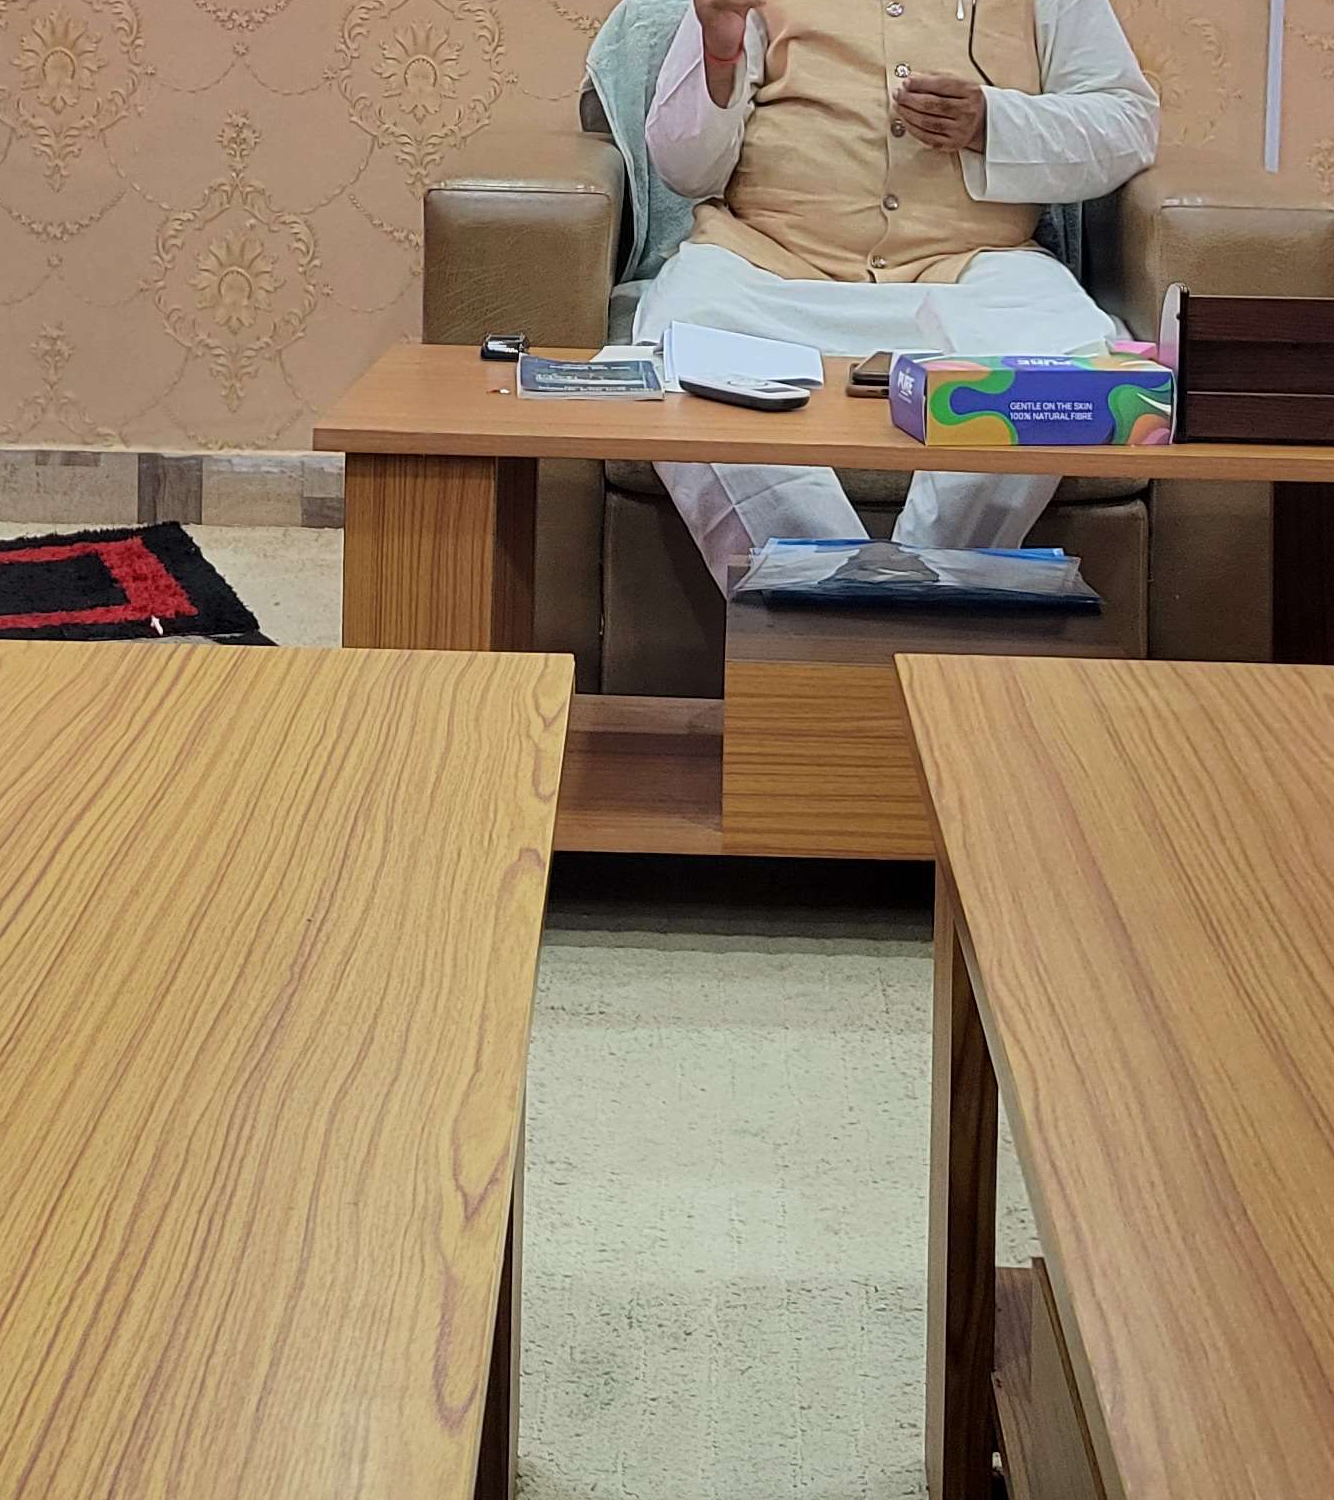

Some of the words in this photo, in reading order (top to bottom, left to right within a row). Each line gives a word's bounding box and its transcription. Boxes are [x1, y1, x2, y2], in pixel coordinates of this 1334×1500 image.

[1009, 402, 1042, 411] GENTLE
[1042, 402, 1055, 411] ON
[1056, 402, 1072, 411] THE
[1073, 402, 1093, 411] SKIN
[1009, 412, 1032, 421] 100%
[1032, 412, 1071, 421] NATURAL
[1071, 412, 1093, 421] FIBRE
